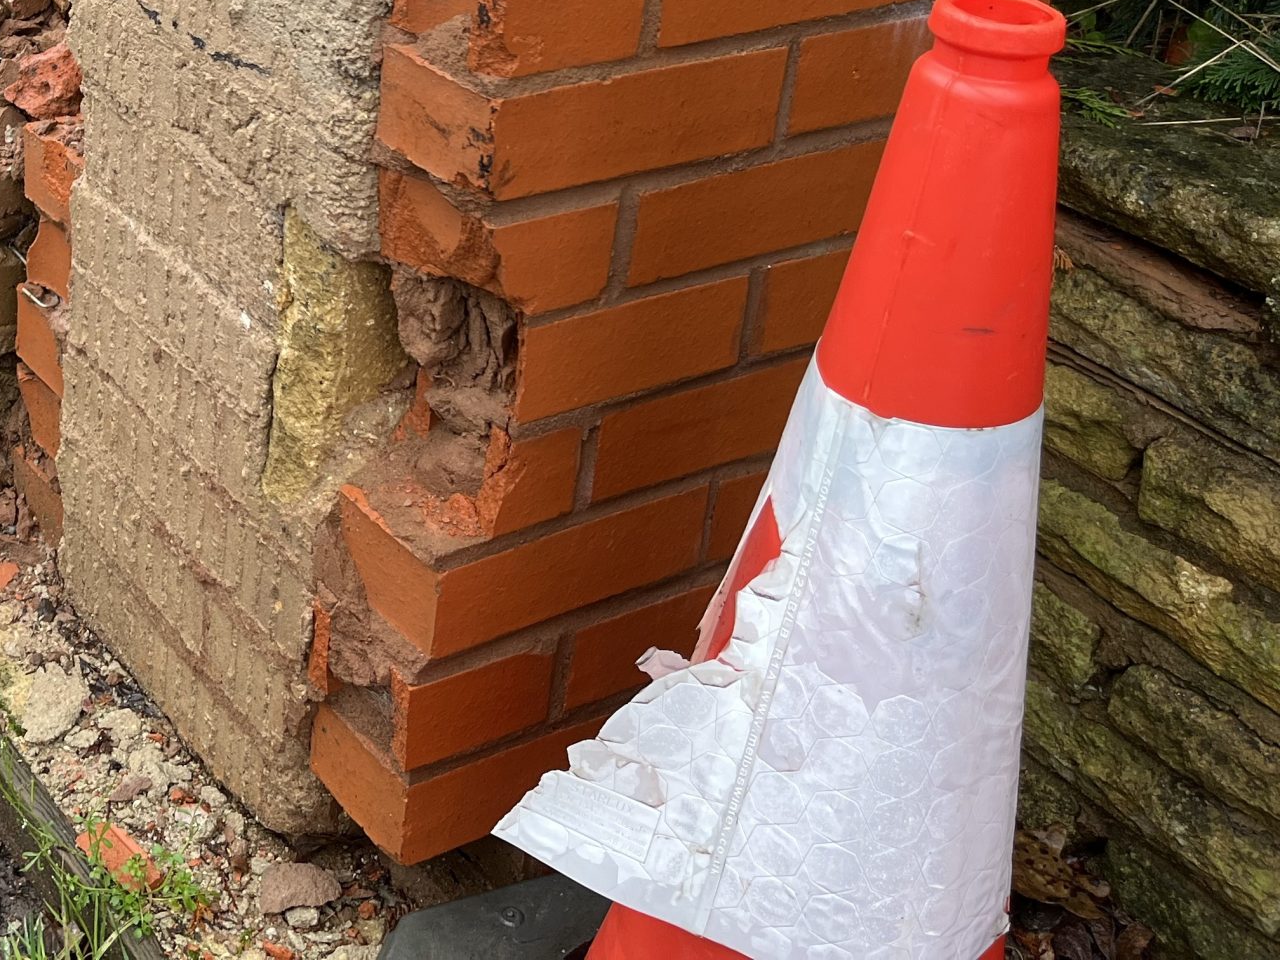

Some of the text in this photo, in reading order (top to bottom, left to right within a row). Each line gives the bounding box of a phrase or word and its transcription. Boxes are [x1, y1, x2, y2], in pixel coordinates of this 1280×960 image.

[812, 468, 834, 523] 750MM
[791, 527, 818, 598] EN13422
[765, 647, 784, 681] R1A
